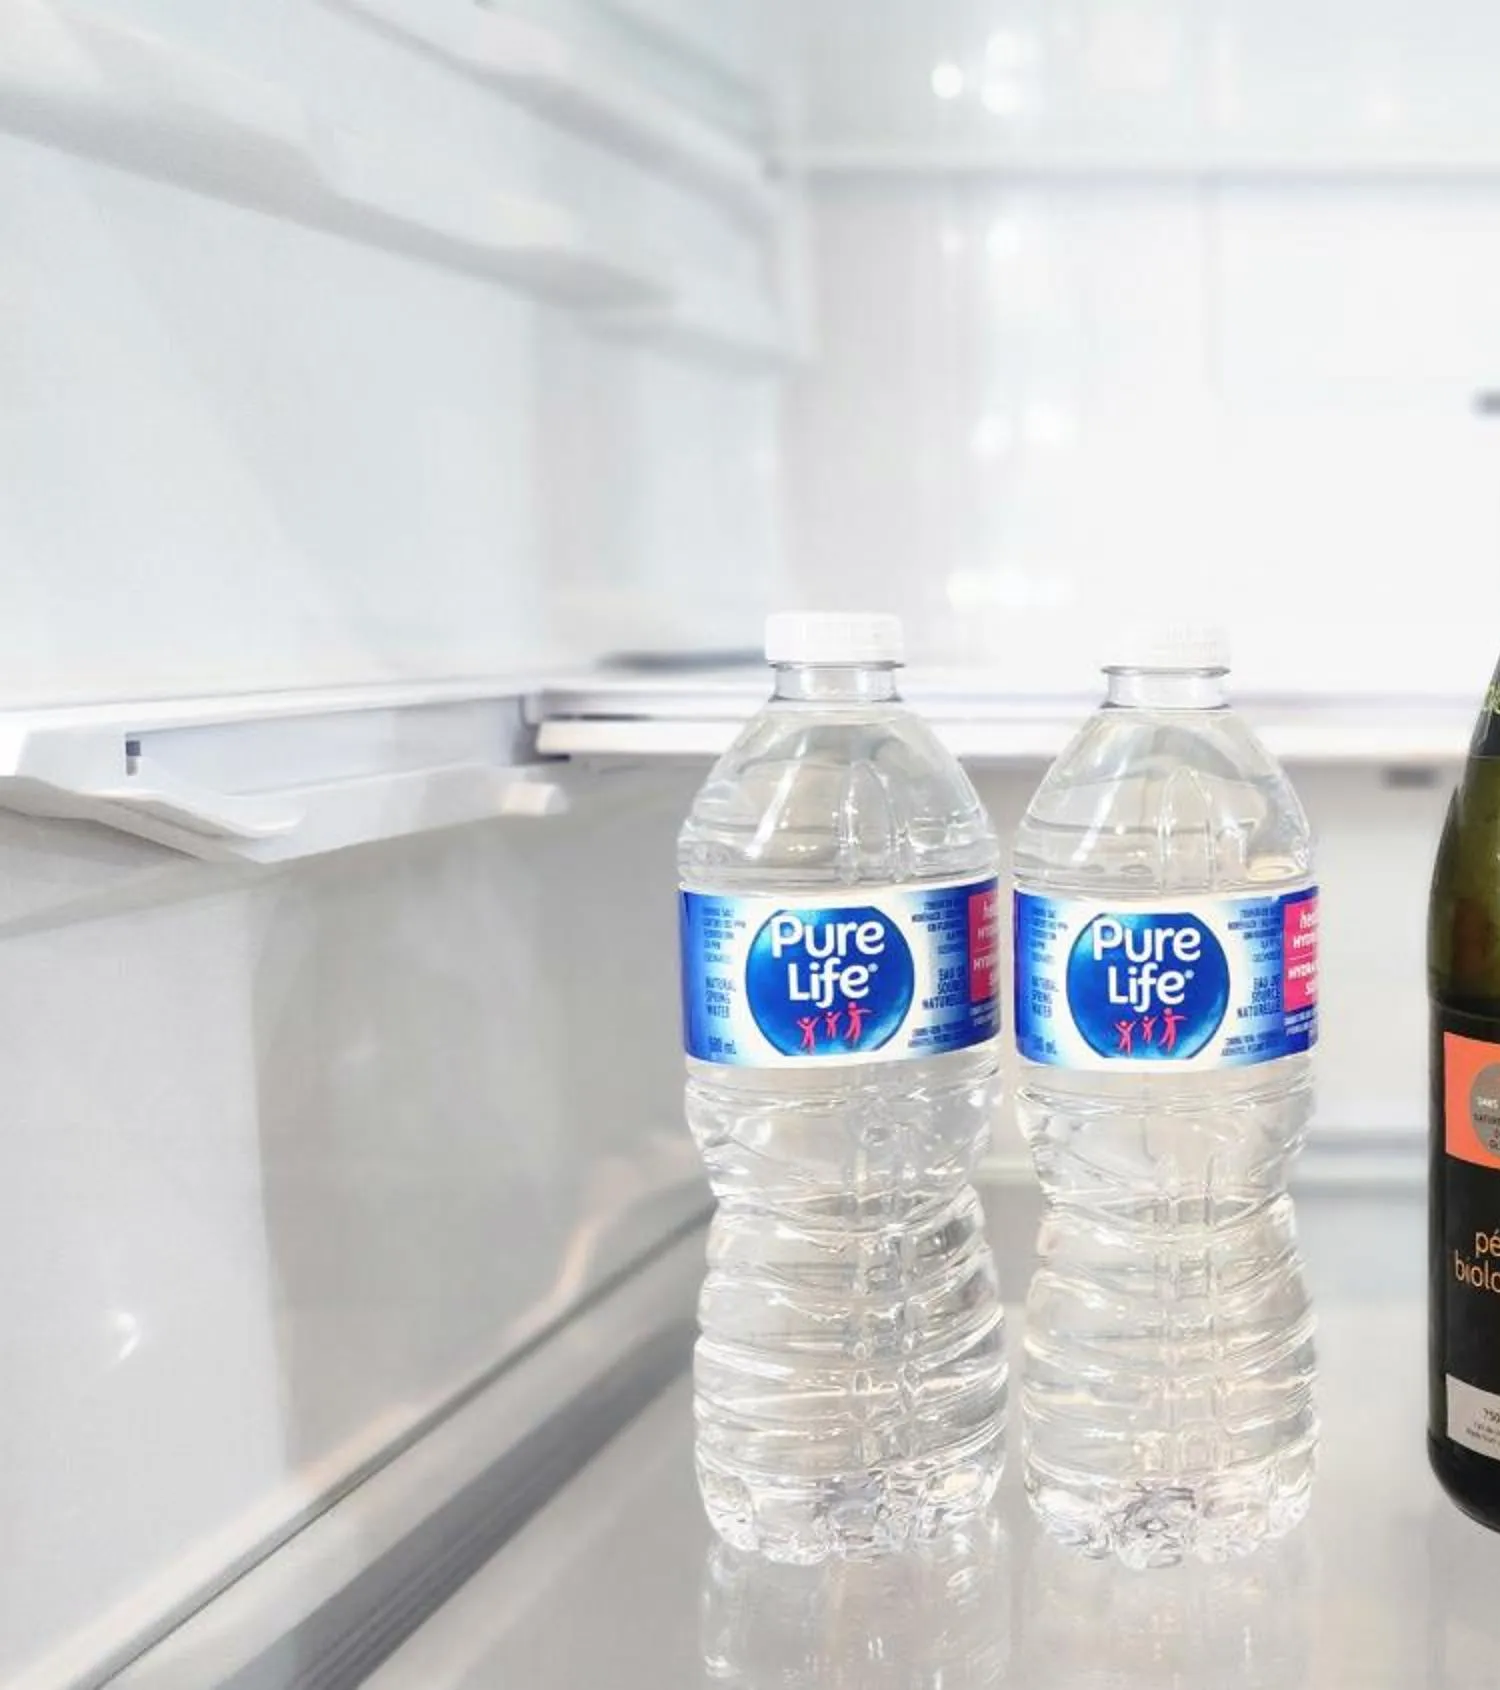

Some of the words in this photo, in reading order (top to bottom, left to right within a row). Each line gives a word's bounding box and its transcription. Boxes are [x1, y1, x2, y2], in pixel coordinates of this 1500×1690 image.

[771, 913, 885, 958] Pure
[1093, 918, 1201, 963] Pure
[788, 957, 869, 1009] Life
[1108, 962, 1185, 1013] Life
